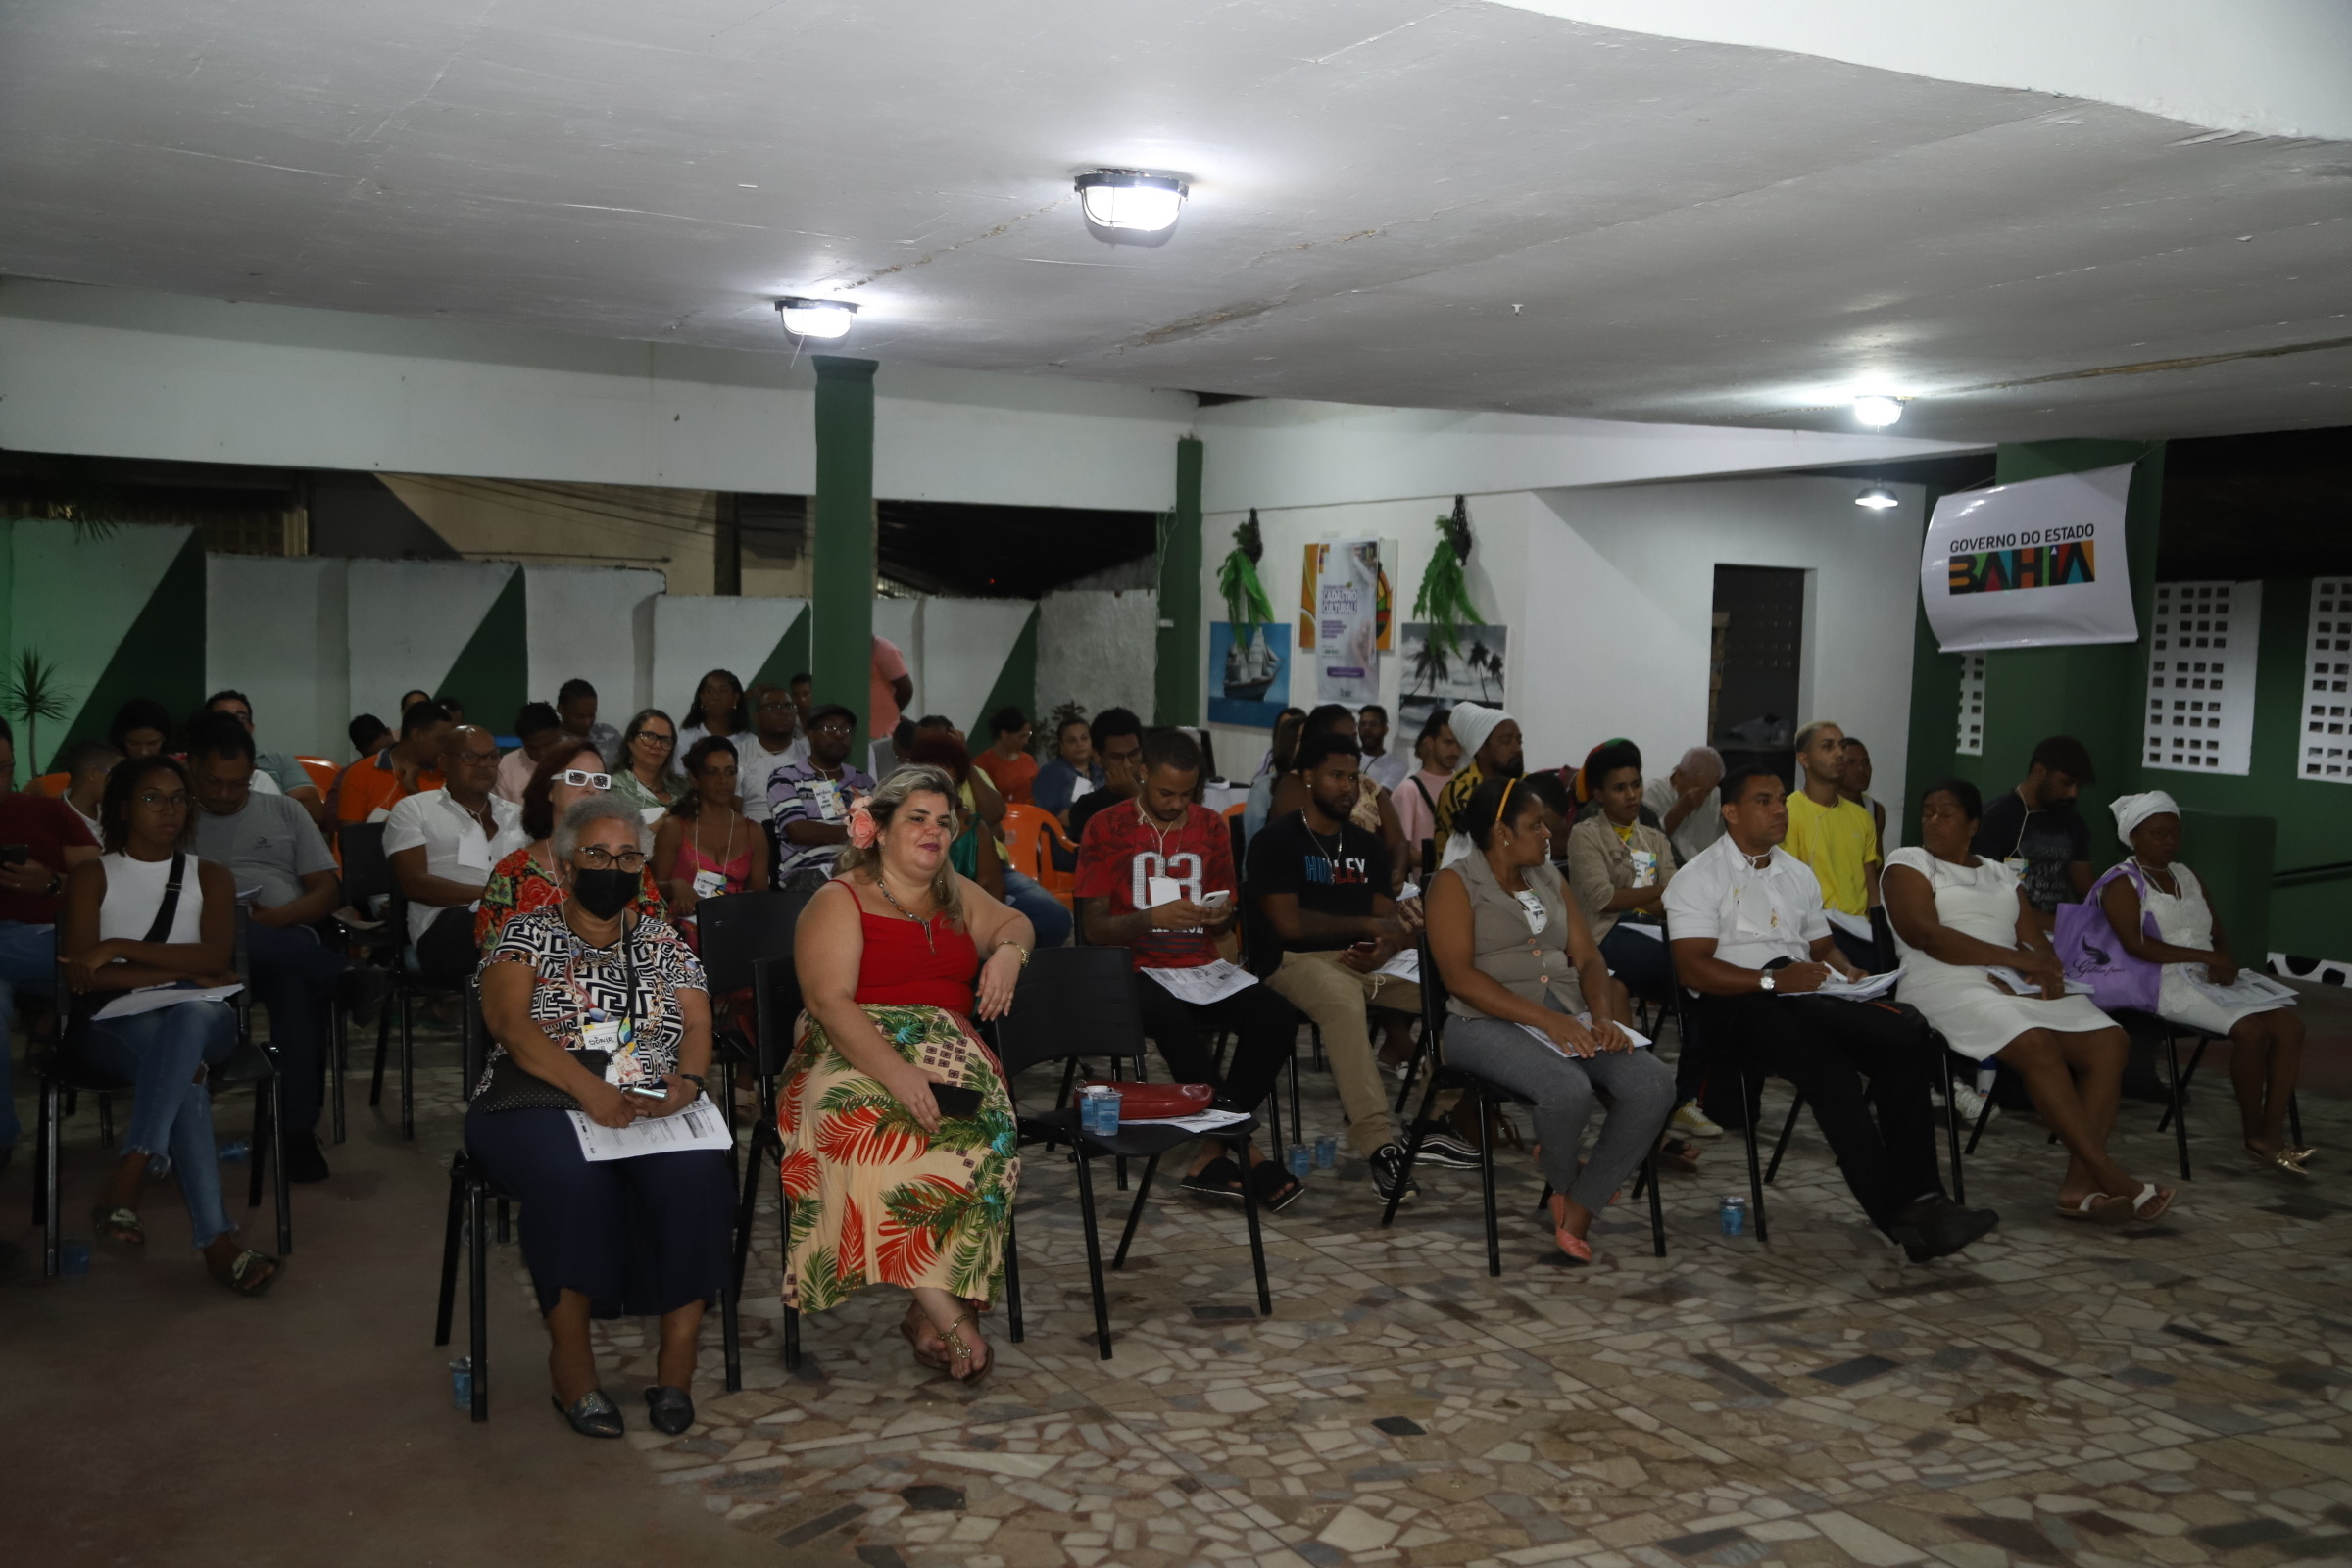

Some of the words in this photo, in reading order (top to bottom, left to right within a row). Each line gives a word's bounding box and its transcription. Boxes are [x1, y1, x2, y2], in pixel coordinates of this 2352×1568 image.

[1950, 533, 2016, 553] GOVERNO
[2021, 531, 2040, 545] DO
[2045, 523, 2094, 543] ESTADO
[1949, 541, 2095, 595] BAHIA
[1323, 590, 1357, 602] CADASTRO
